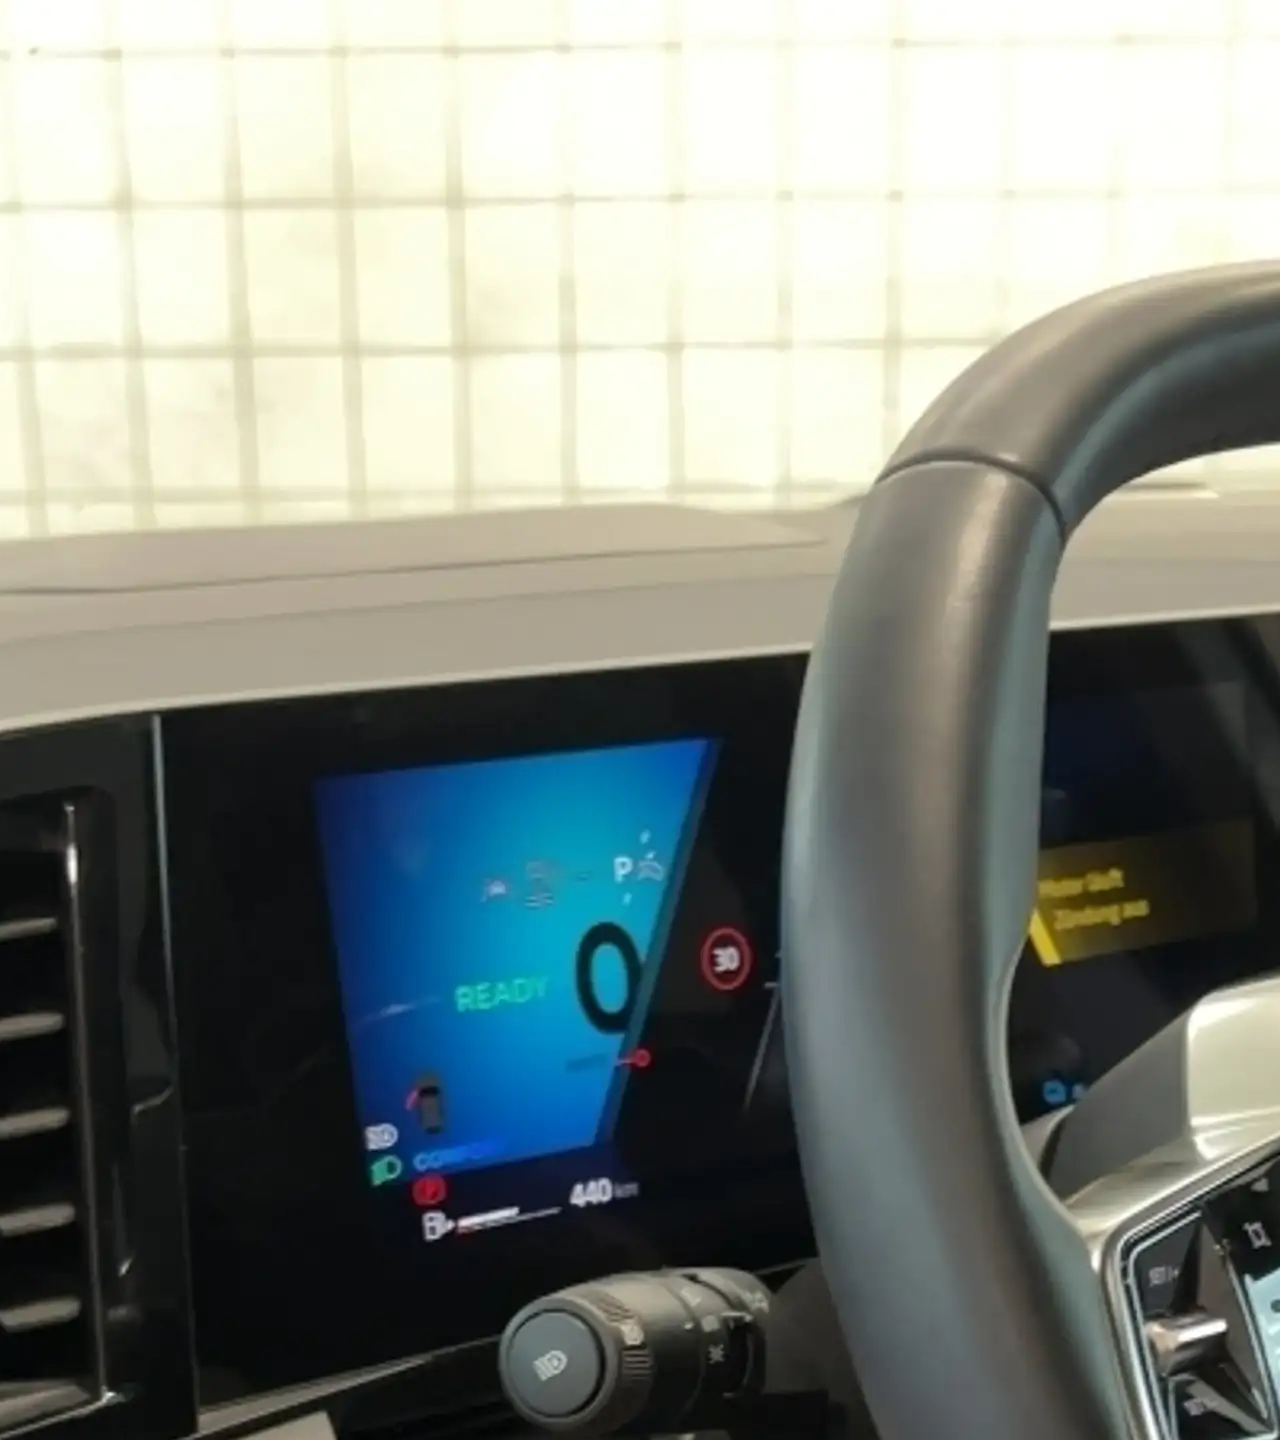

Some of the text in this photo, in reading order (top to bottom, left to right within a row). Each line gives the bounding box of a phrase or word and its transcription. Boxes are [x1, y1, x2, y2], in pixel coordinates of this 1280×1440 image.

[613, 856, 633, 883] P
[711, 945, 741, 974] 30
[454, 974, 550, 1013] READY
[575, 921, 641, 1035] 0
[568, 1177, 613, 1208] 440
